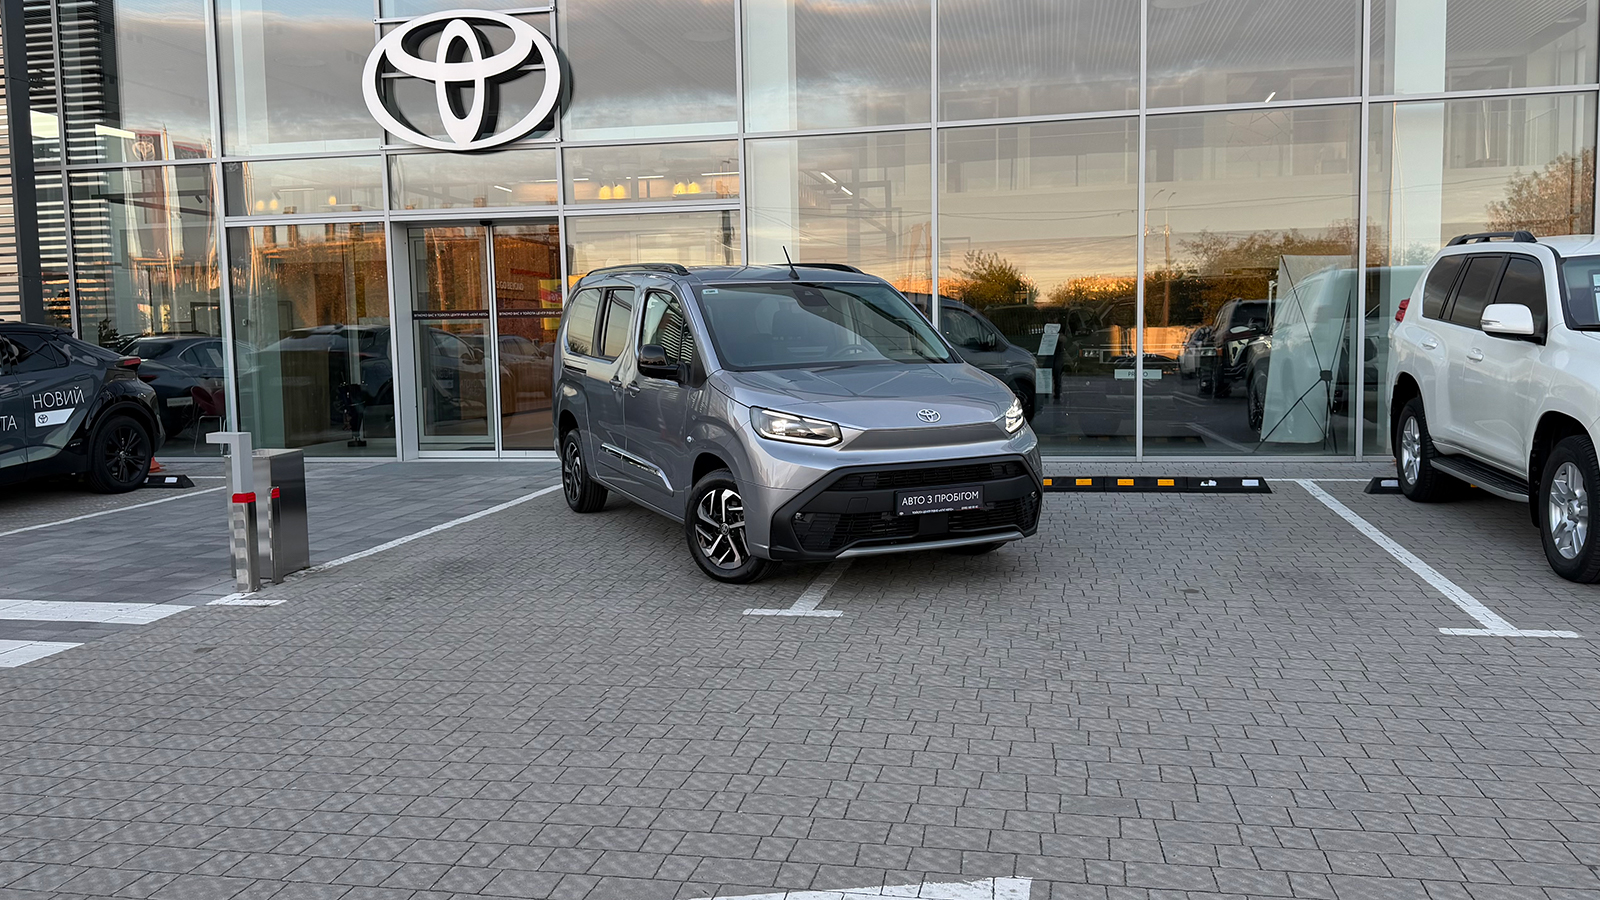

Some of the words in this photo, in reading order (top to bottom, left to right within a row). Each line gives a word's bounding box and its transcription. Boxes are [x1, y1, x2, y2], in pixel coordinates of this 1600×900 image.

[32, 386, 85, 409] НОВИЙ
[902, 496, 925, 506] АВТО
[927, 495, 932, 504] З
[934, 491, 979, 503] ПРОБІГОМ
